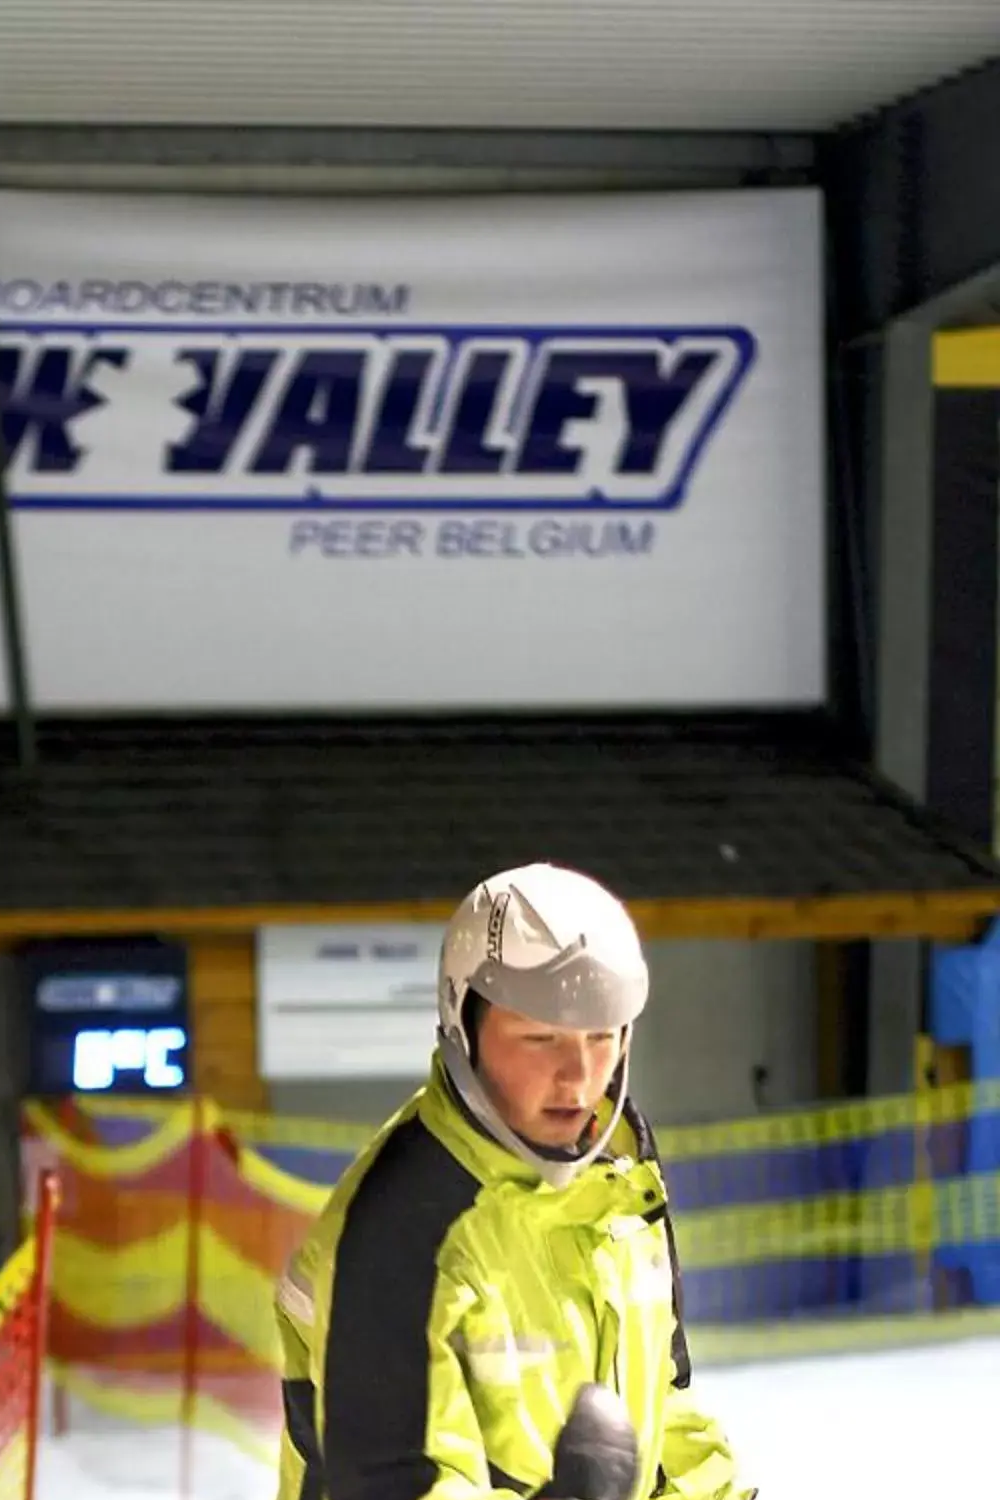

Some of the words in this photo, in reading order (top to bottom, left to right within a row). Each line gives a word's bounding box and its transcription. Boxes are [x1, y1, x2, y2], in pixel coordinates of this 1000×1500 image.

[163, 347, 723, 475] VALLEY
[288, 519, 425, 558] PEER
[436, 519, 656, 559] BELGIUM
